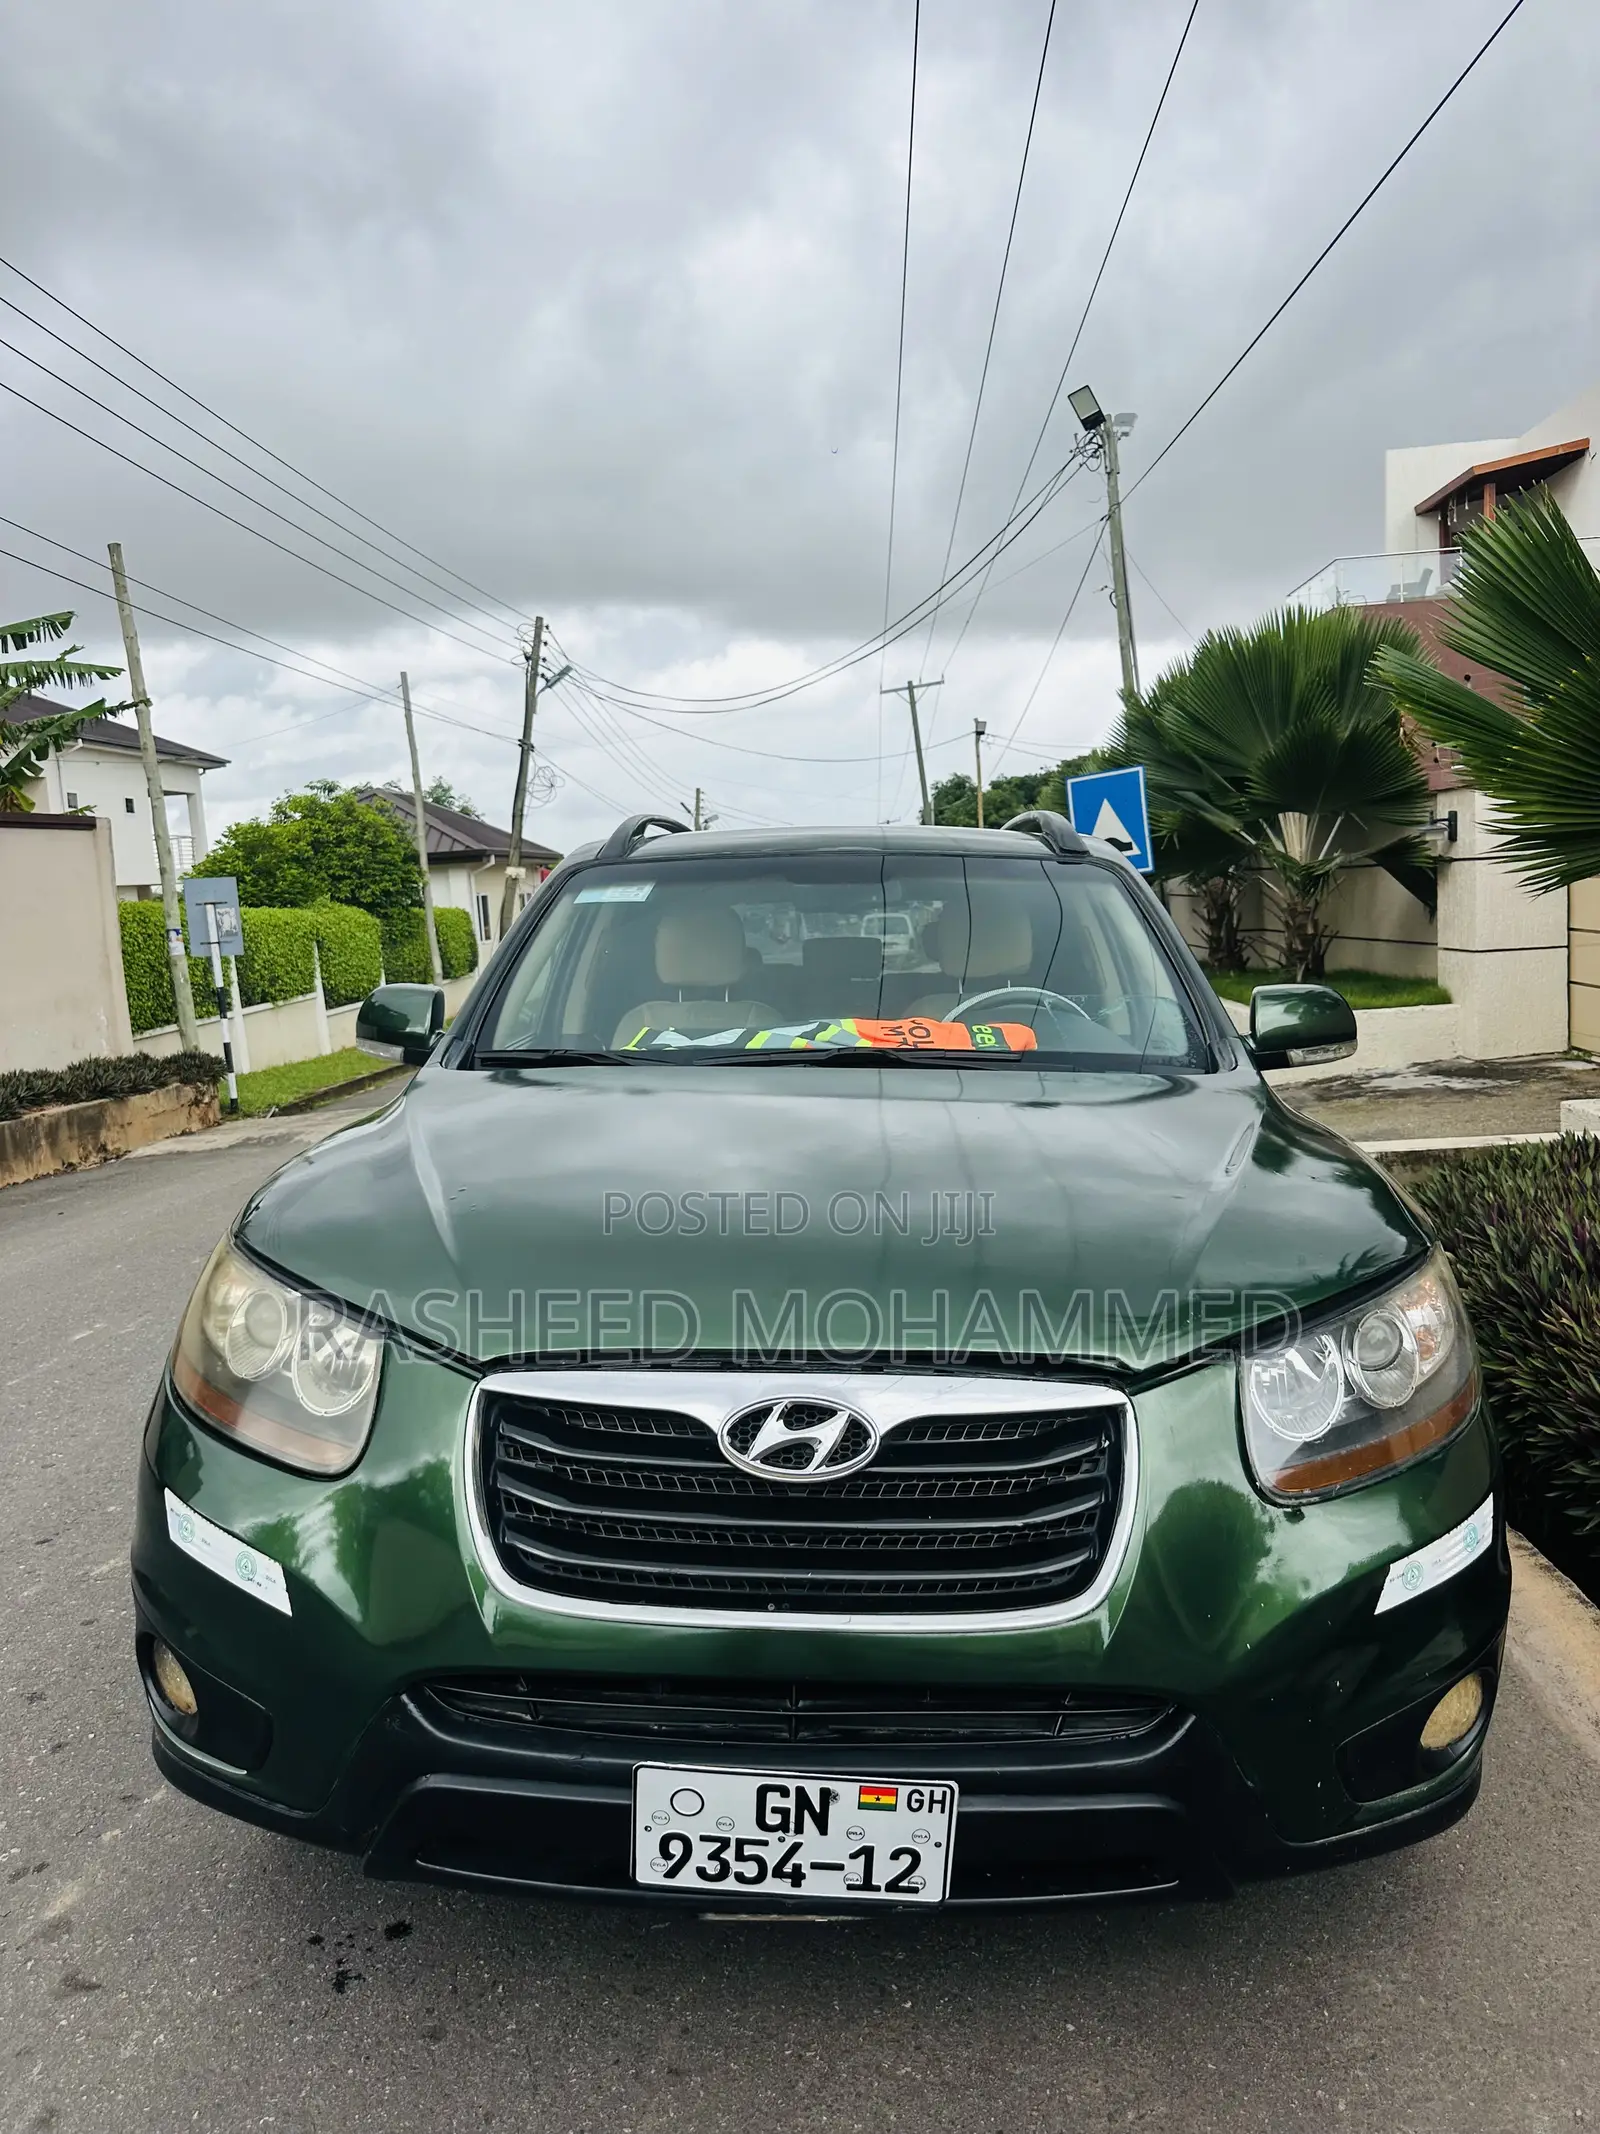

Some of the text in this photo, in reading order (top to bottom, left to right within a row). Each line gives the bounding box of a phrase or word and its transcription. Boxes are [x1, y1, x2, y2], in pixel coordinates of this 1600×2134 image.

[755, 1783, 831, 1836] GN
[906, 1788, 946, 1814] GH
[659, 1832, 922, 1894] 9354-12
